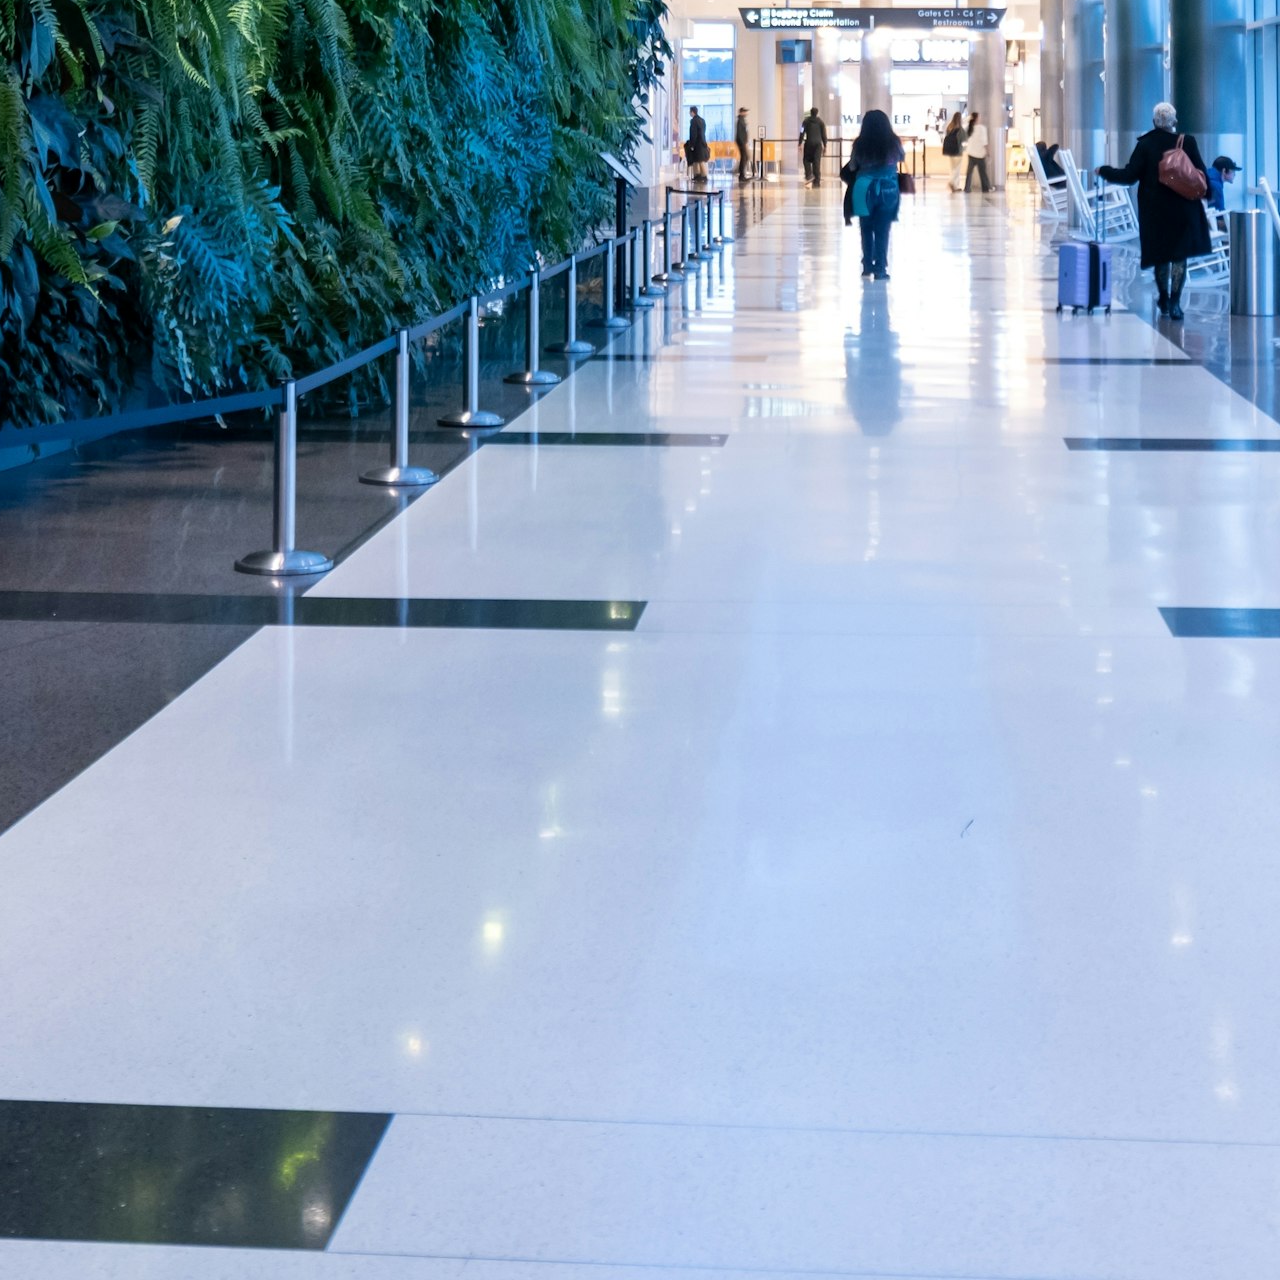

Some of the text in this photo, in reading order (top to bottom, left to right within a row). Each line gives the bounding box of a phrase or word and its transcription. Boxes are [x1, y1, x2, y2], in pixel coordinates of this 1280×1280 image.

[771, 8, 834, 19] Baggage Claim
[771, 18, 860, 28] Ground Transportation
